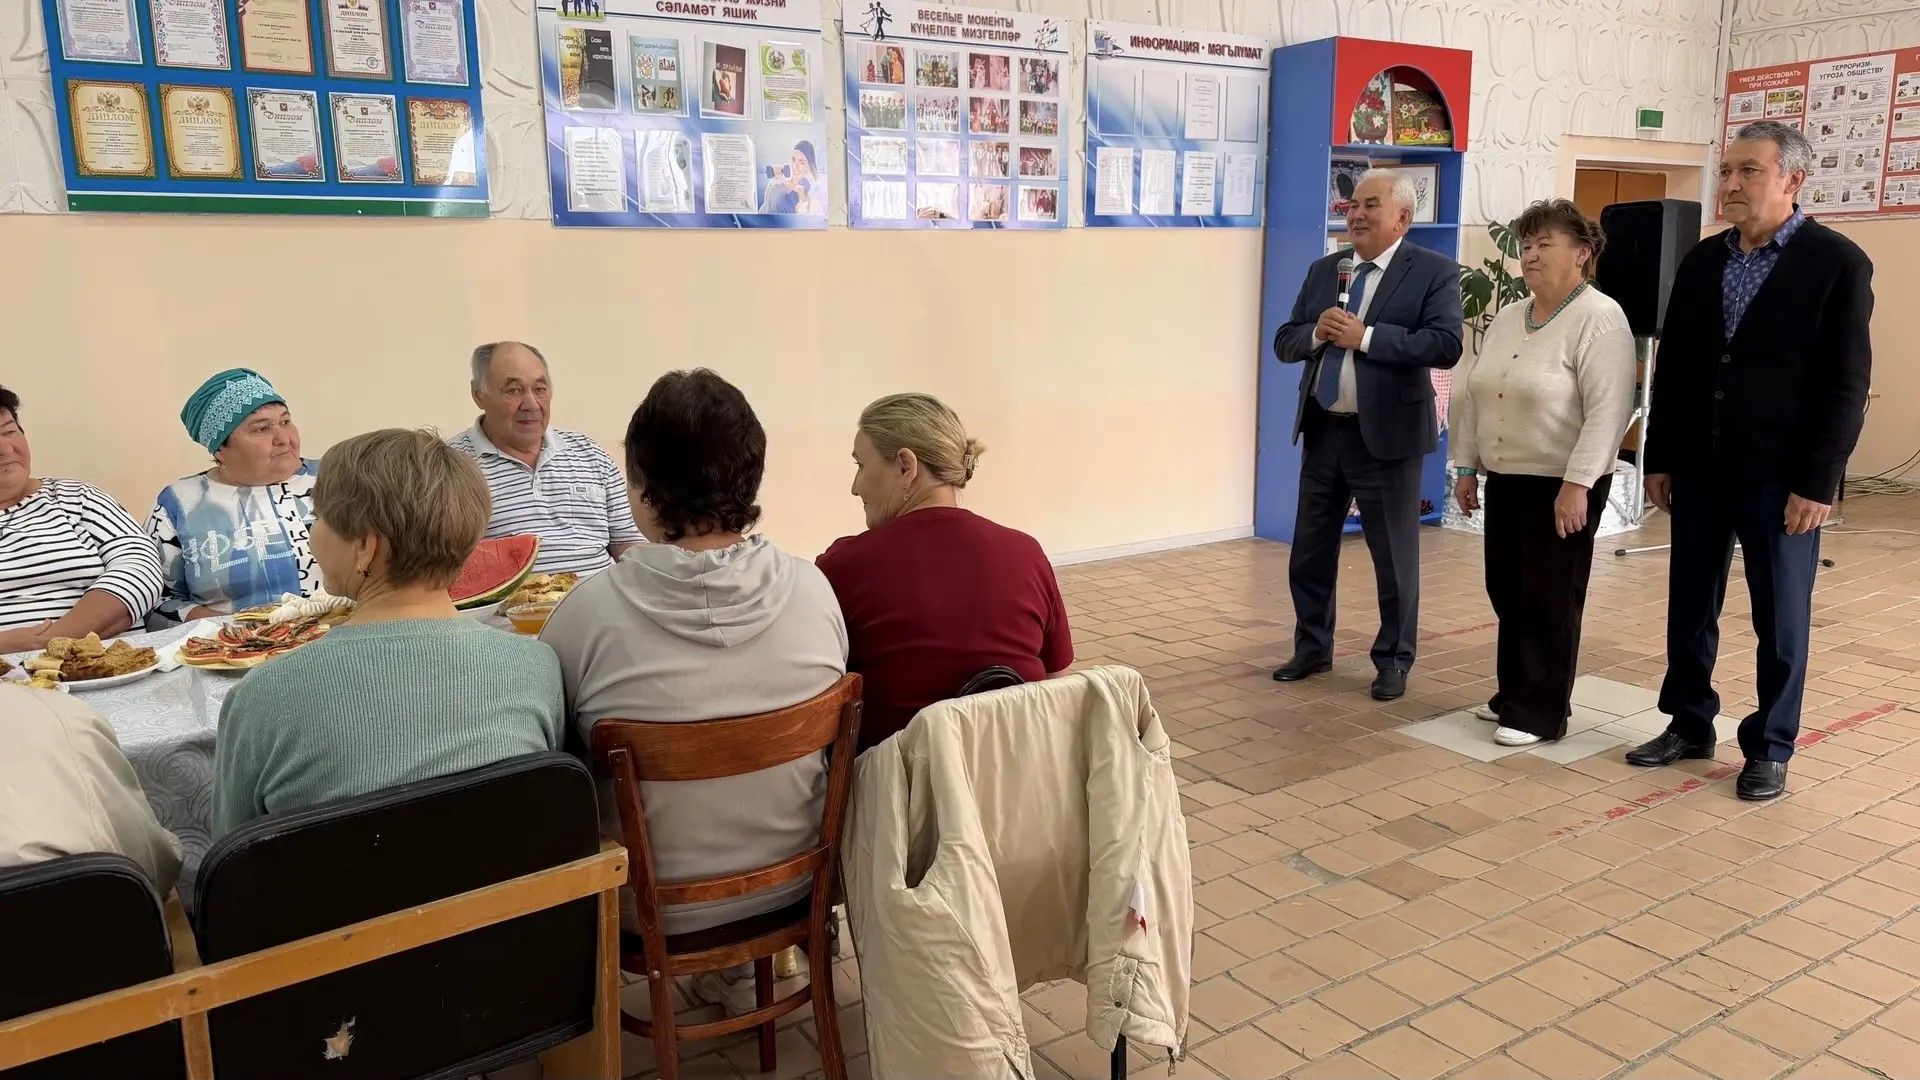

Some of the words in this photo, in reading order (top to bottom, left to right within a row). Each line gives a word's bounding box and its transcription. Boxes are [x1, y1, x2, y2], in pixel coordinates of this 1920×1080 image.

[656, 1, 716, 16] СӘЛАМӘТ
[722, 7, 758, 20] ЯШИК
[918, 9, 963, 23] ВЕСЕЛЫЕ
[967, 14, 1014, 28] МОМЕНТЫ
[961, 27, 1021, 42] МИЗГЕЛЛӘР
[1130, 35, 1200, 54] ИНФОРМАЦИЯ
[1756, 70, 1802, 82] ДЕЙСТВОВАТЬ
[1819, 72, 1844, 81] УГРОЗА
[1846, 66, 1884, 77] ОБЩЕСТВУ
[1748, 81, 1762, 89] ПРИ
[1762, 78, 1790, 87] ПОЖАРЕ
[88, 112, 134, 122] ДИПЛОМ
[178, 116, 222, 125] ДИПЛОМ
